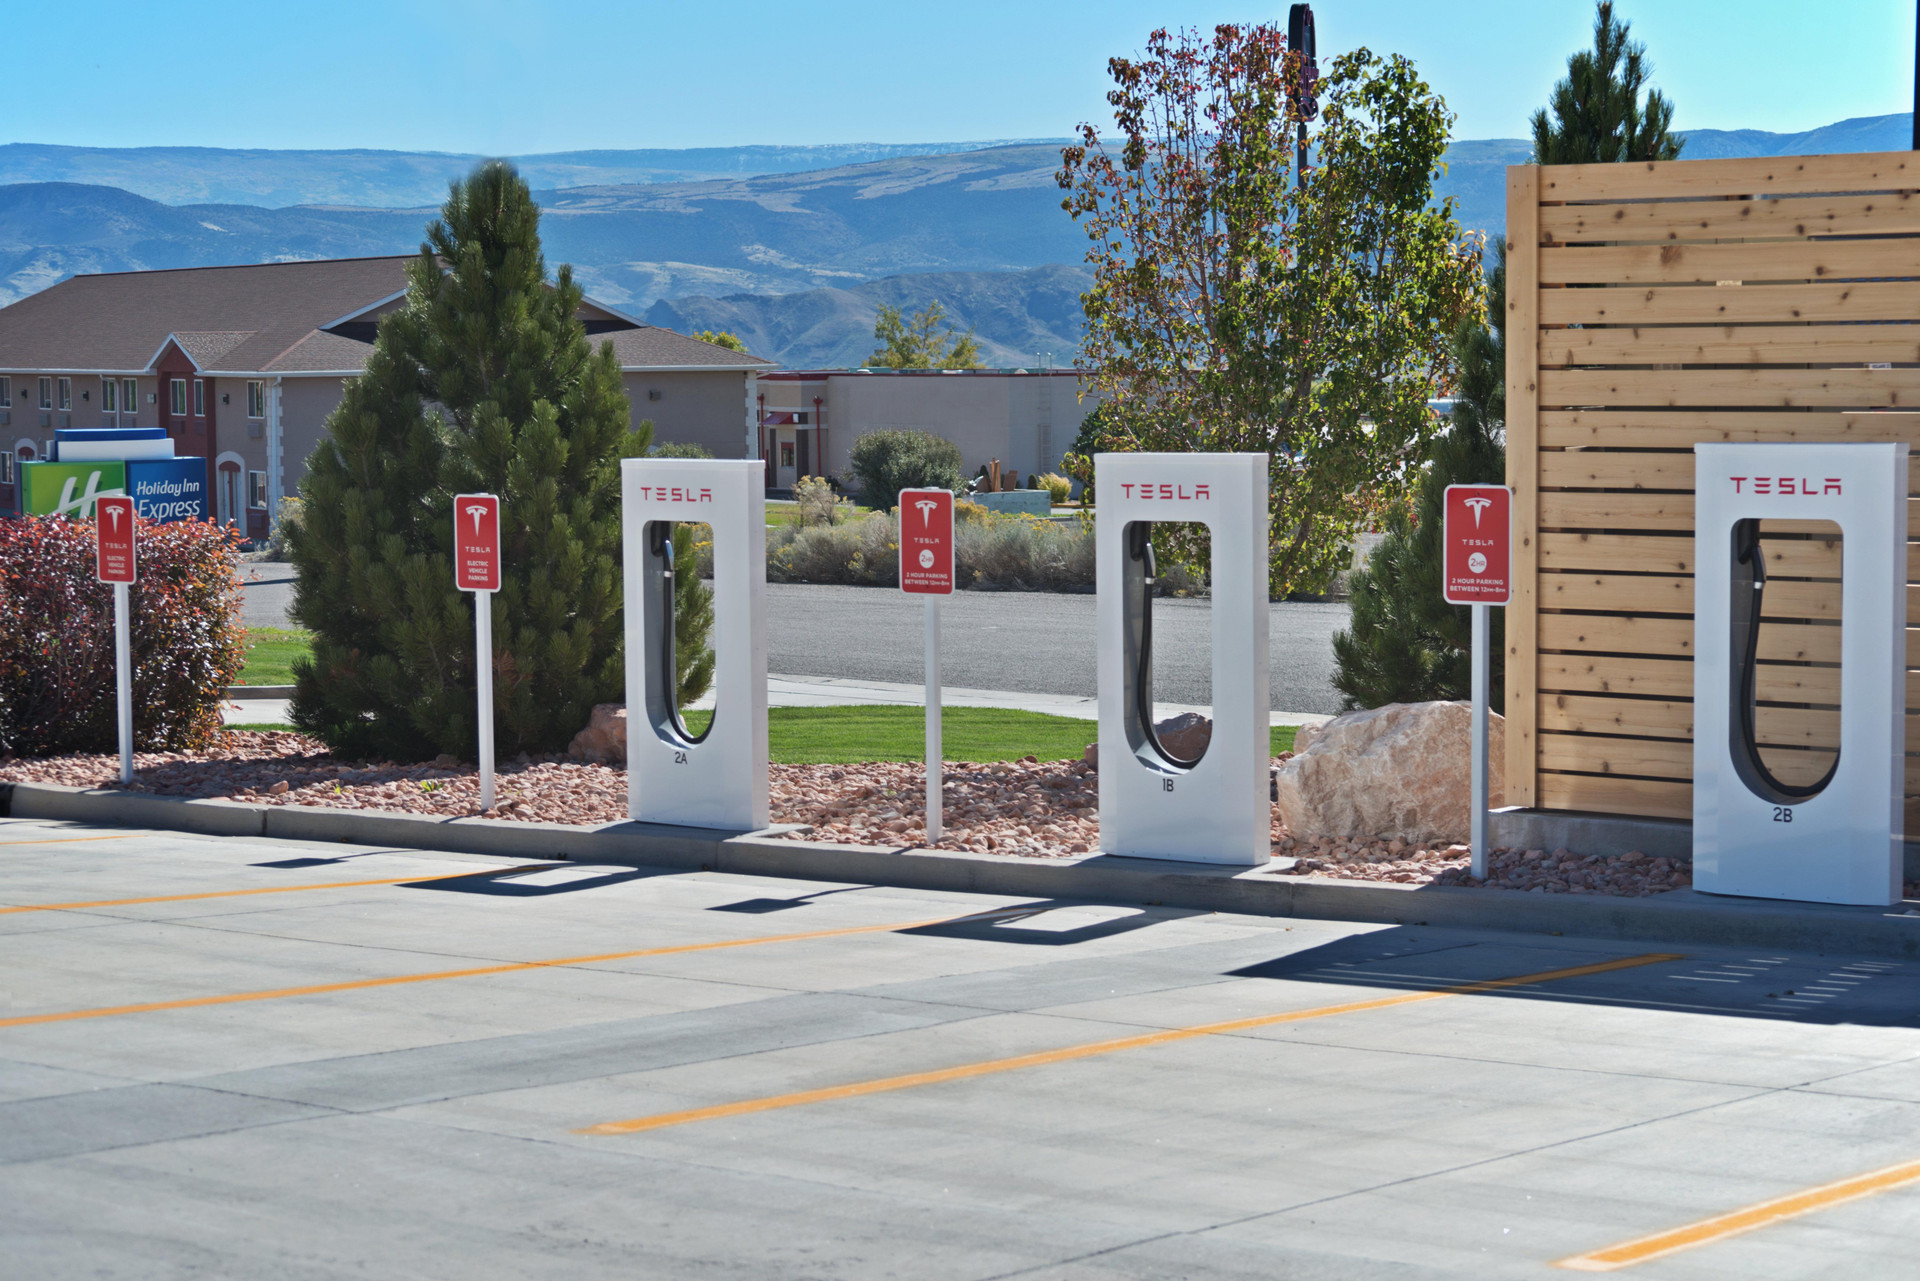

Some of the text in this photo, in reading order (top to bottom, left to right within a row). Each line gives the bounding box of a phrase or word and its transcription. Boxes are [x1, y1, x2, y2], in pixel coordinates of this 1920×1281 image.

[136, 478, 200, 497] Holiday Inn
[1121, 484, 1210, 500] TESLA
[1729, 476, 1842, 495] TESLA
[640, 487, 712, 502] TESLA
[138, 499, 200, 523] Express
[1461, 538, 1494, 546] TESLA
[1470, 558, 1485, 567] 2HR
[675, 751, 688, 765] 2A
[1162, 778, 1174, 792] 1B
[1773, 806, 1793, 823] 2B
